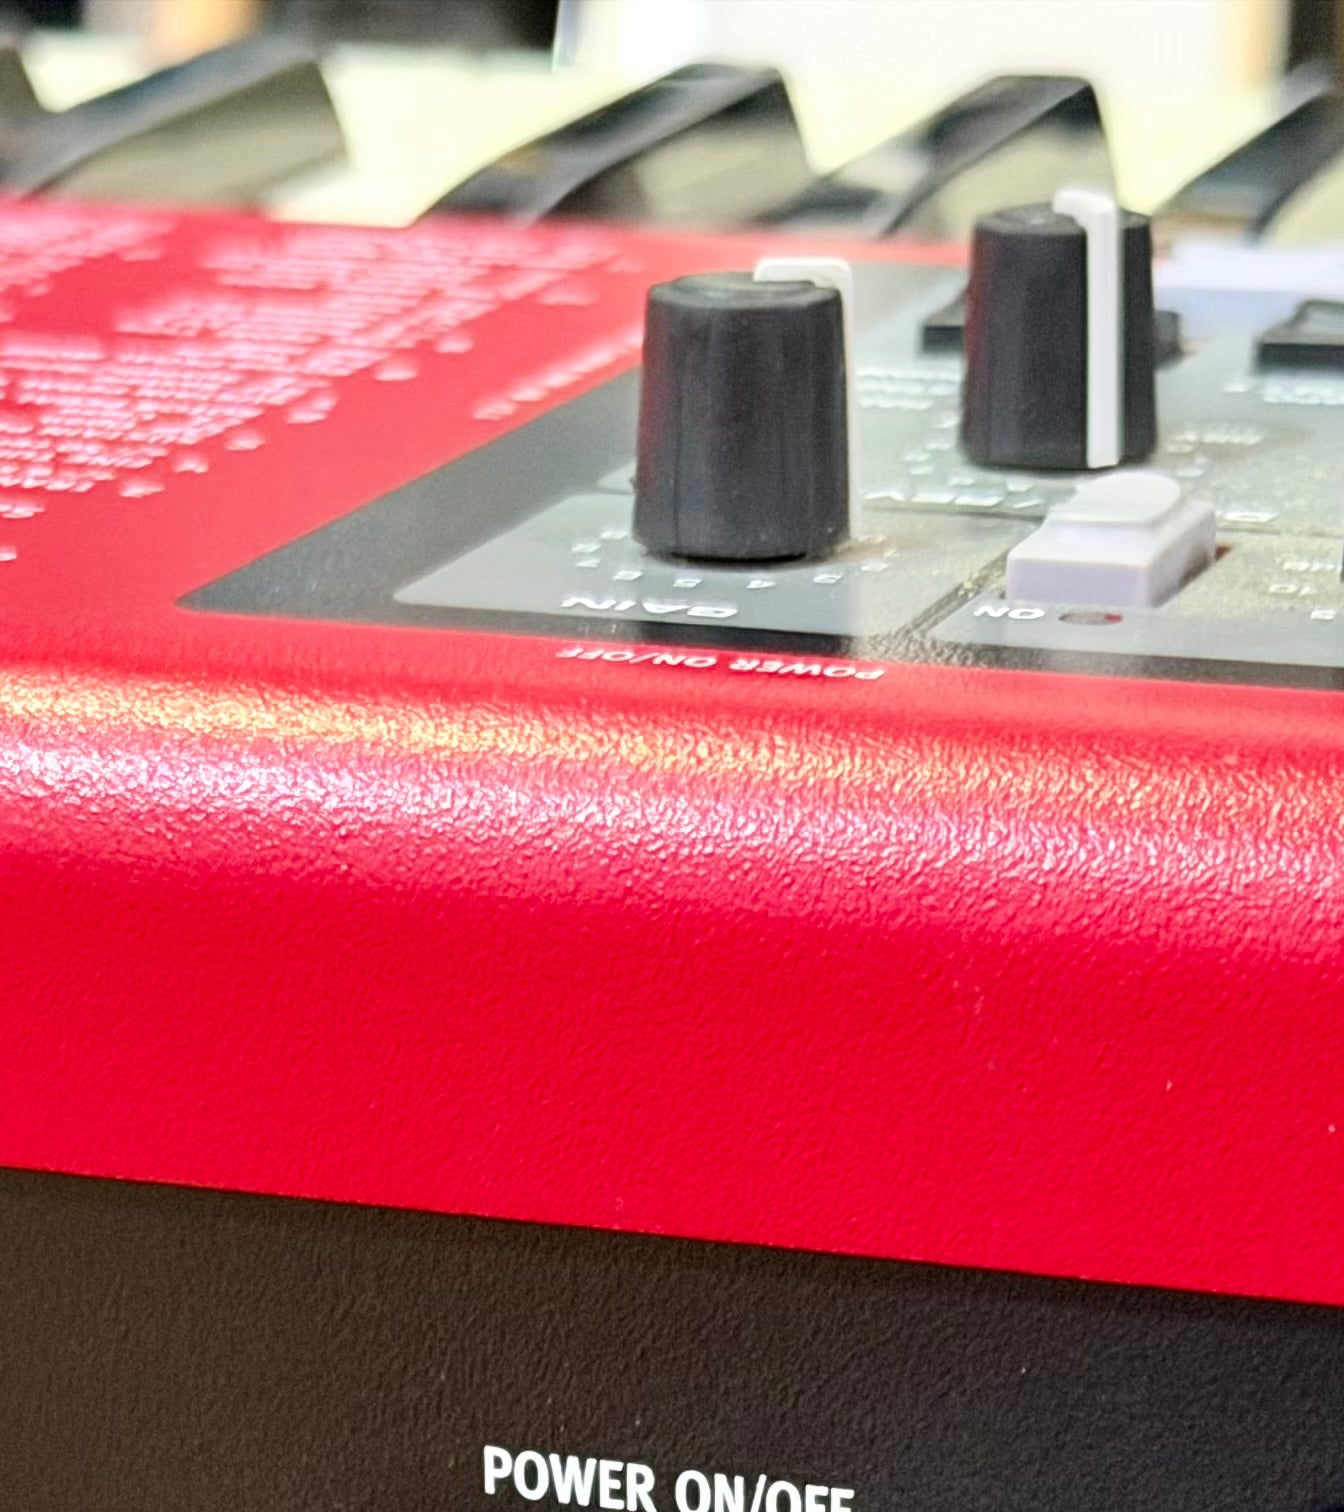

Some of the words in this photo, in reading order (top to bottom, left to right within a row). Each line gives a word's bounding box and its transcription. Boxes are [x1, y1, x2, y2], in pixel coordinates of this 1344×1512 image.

[560, 597, 739, 618] GAIN
[973, 603, 1045, 620] ON
[556, 647, 717, 669] ON/OFF
[728, 657, 885, 680] POWER
